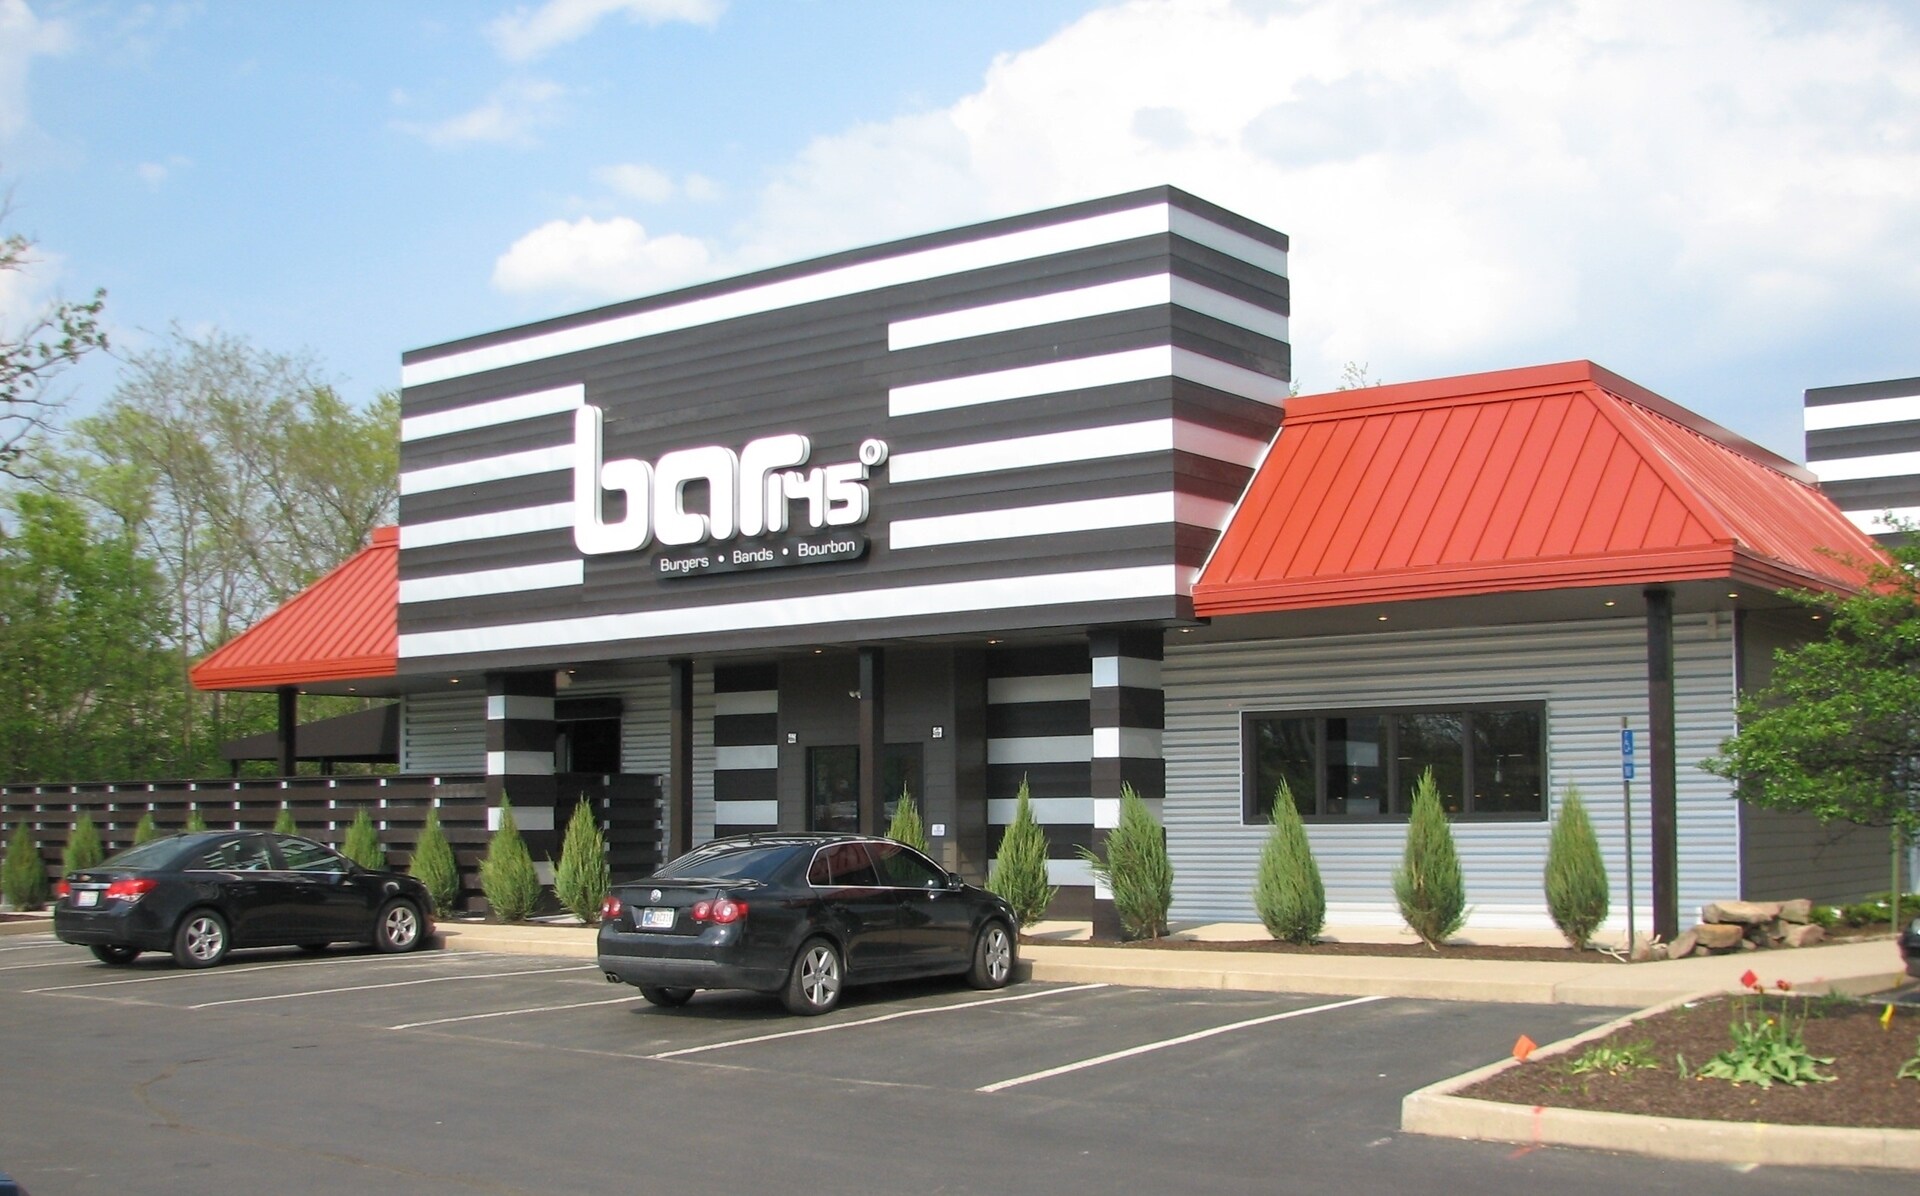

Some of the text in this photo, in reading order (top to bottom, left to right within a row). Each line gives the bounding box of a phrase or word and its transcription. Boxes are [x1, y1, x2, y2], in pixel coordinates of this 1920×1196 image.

[574, 404, 811, 555] bar
[660, 540, 855, 573] Burgers Bands Bourbon
